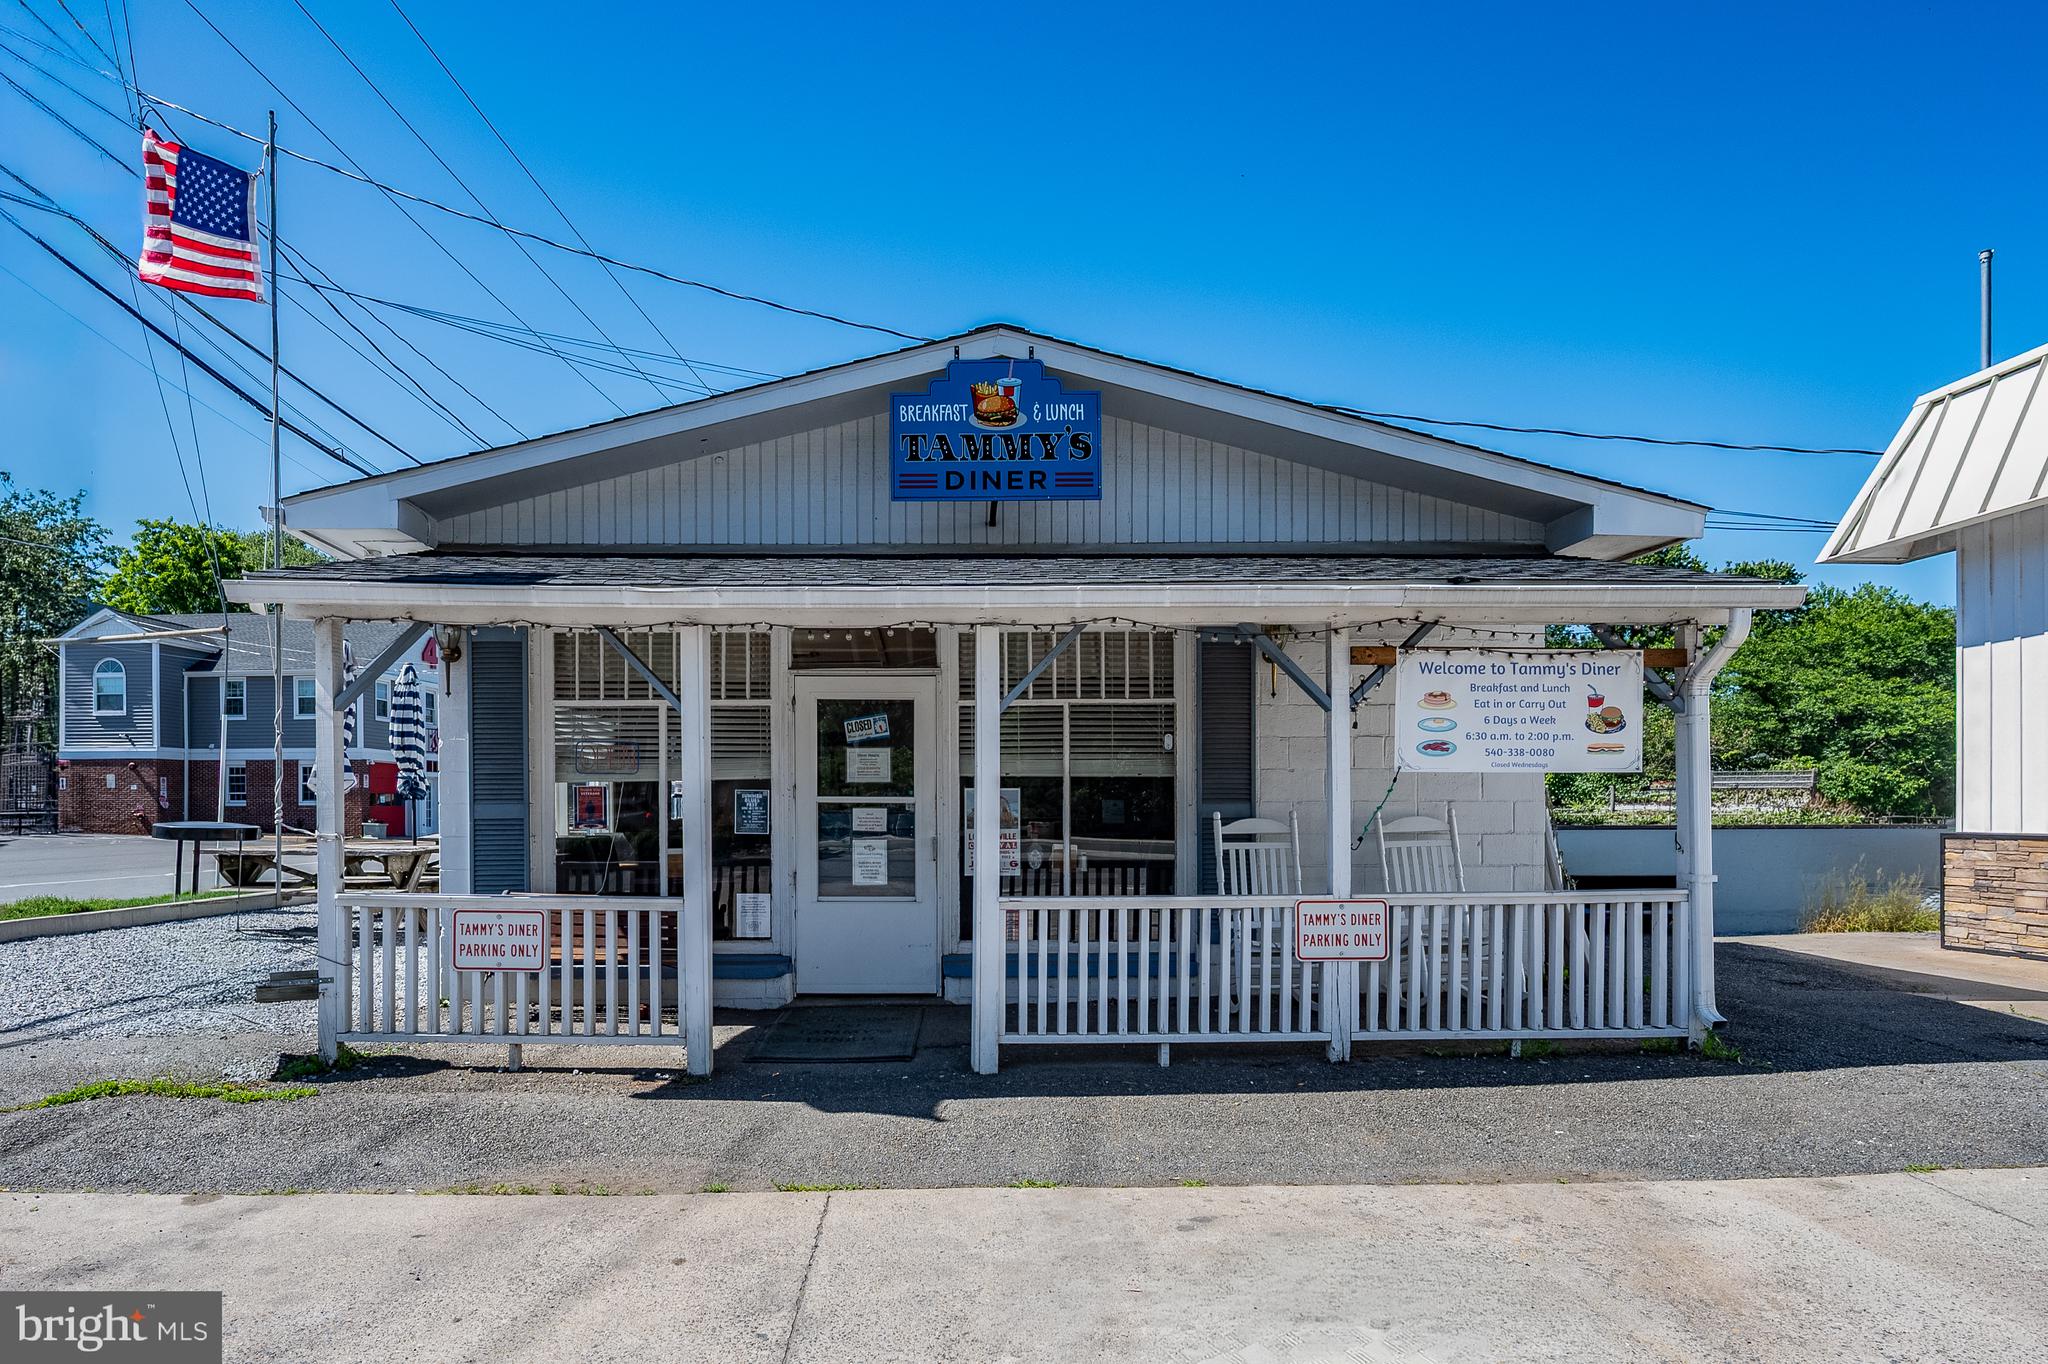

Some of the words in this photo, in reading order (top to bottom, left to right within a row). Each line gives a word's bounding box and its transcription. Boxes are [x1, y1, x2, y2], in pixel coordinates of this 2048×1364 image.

[900, 404, 968, 422] BREAKFAST
[1033, 401, 1041, 423] &
[1046, 404, 1084, 421] LUNCH
[899, 425, 1093, 462] TAMMY'S
[946, 471, 1047, 490] DINER
[1419, 661, 1486, 675] Welcome
[1491, 663, 1506, 675] to
[1510, 662, 1577, 678] Tammy's
[1582, 662, 1620, 675] Diner
[1470, 683, 1518, 693] Breakfast
[1521, 684, 1539, 692] and
[1542, 684, 1570, 692] Lunch
[1474, 700, 1490, 708] Eat
[1493, 700, 1502, 708] in
[1519, 700, 1545, 710] Carry
[1548, 700, 1566, 709] Out
[846, 719, 872, 734] CLOSED
[1484, 716, 1490, 724] 6
[1493, 716, 1518, 726] Days
[1529, 716, 1556, 724] Week
[1466, 732, 1487, 741] 6:30
[1515, 733, 1525, 741] to
[1528, 732, 1549, 741] 2:00
[1552, 734, 1574, 743] p.m.
[1485, 748, 1555, 757] 540-338-0080
[1304, 914, 1346, 925] TAMMY'S
[1351, 914, 1381, 925] DINER
[460, 923, 503, 936] TAMMY'S
[508, 924, 538, 936] DINER
[1304, 934, 1349, 947] PARKING
[1354, 934, 1381, 946] ONLY
[460, 944, 505, 957] PARKING
[511, 945, 538, 957] ONLY
